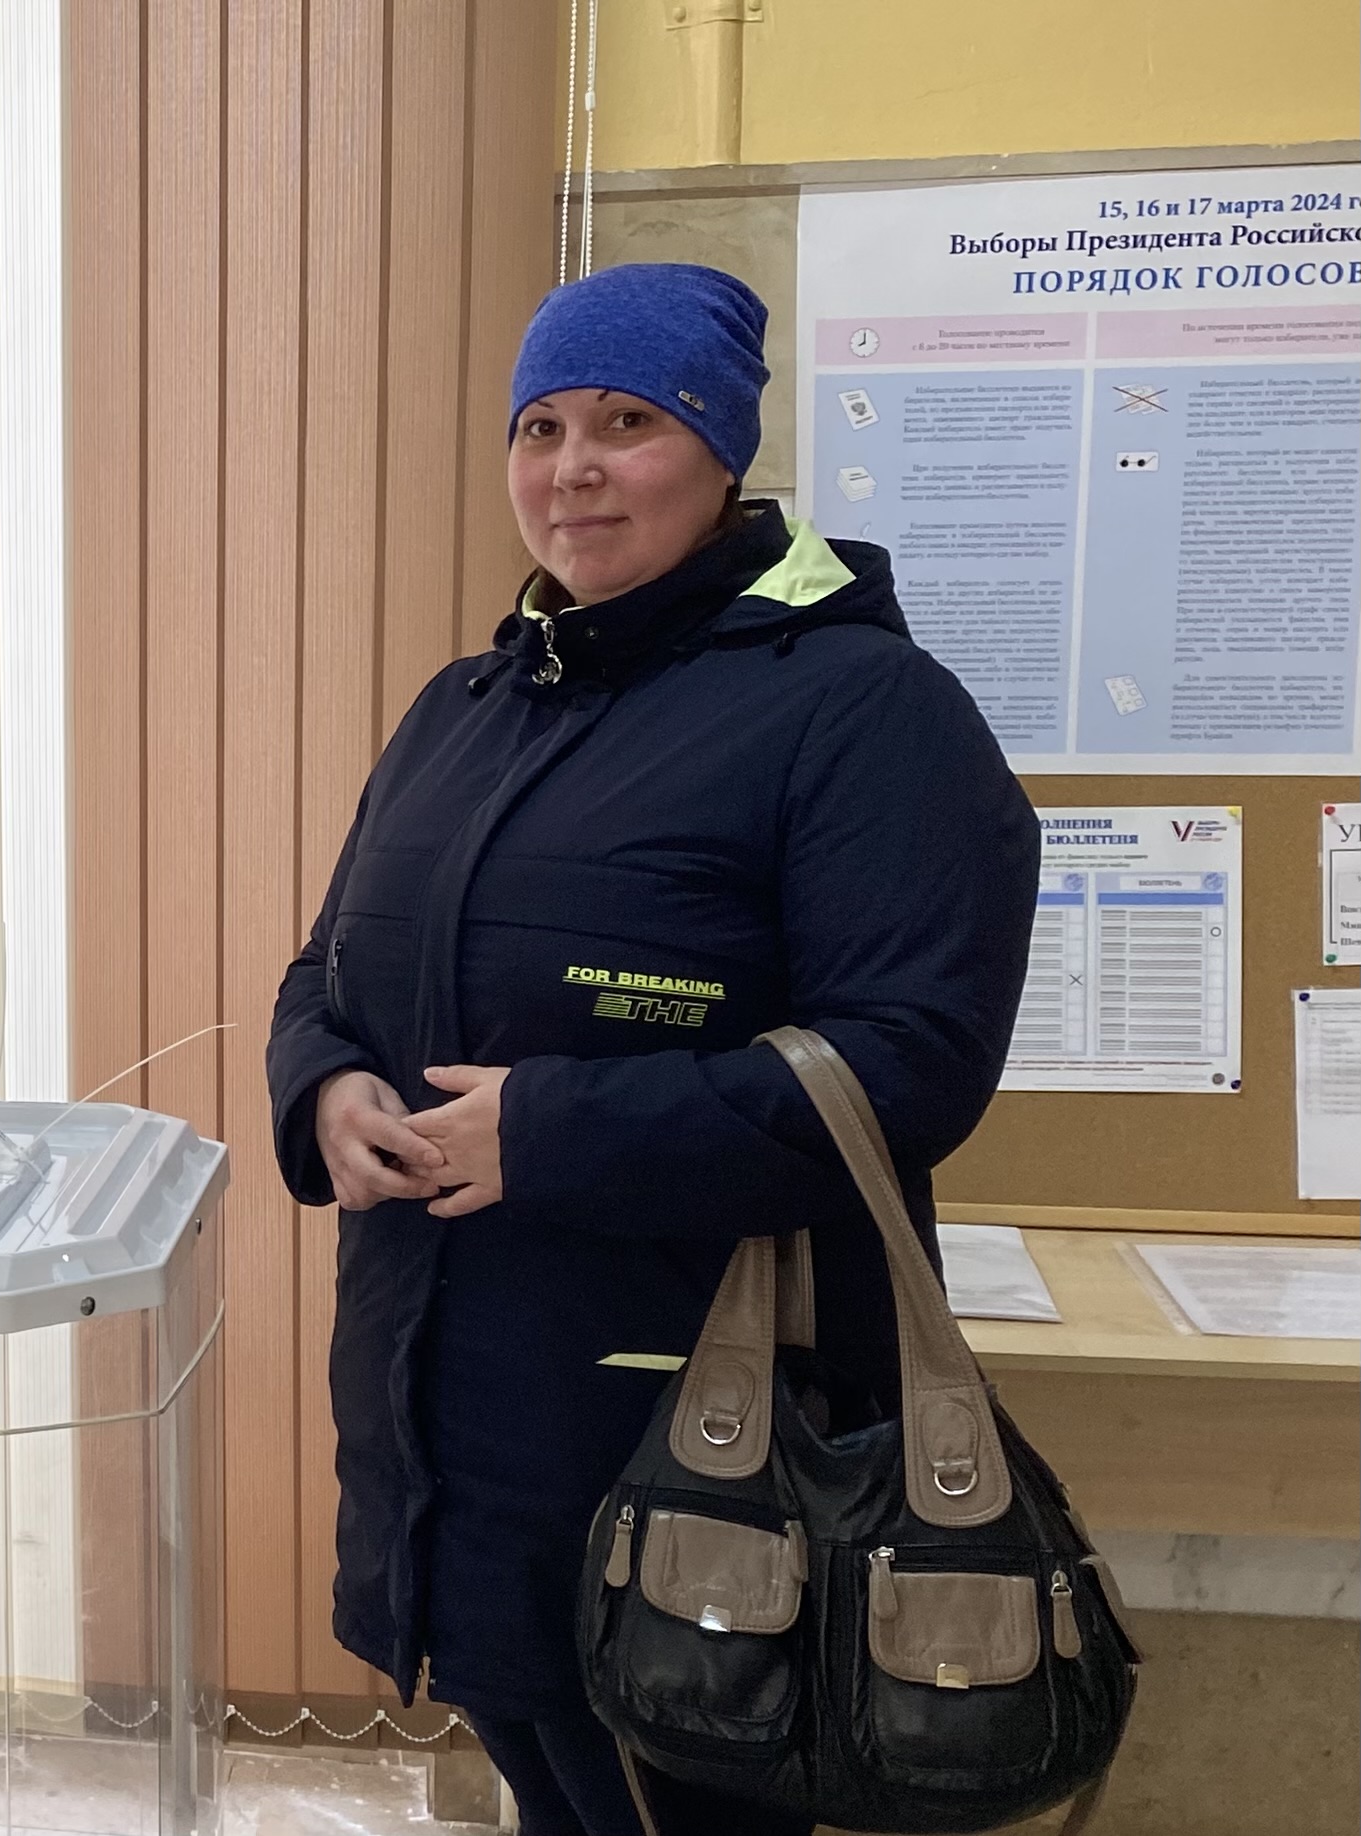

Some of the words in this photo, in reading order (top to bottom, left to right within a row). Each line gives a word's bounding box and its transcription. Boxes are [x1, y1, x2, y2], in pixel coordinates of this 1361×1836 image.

[1098, 200, 1129, 220] 15,
[1136, 199, 1160, 217] 16
[1166, 202, 1180, 216] и
[1188, 197, 1212, 215] 17
[1217, 197, 1284, 219] марта
[1290, 193, 1342, 212] 2024
[1348, 196, 1361, 210] г
[949, 232, 1058, 259] Выборы
[1065, 228, 1222, 257] Президента
[1013, 267, 1183, 296] ПОРЯДОК
[567, 966, 611, 983] FOR
[618, 972, 724, 996] BREAKING
[622, 995, 708, 1027] THE
